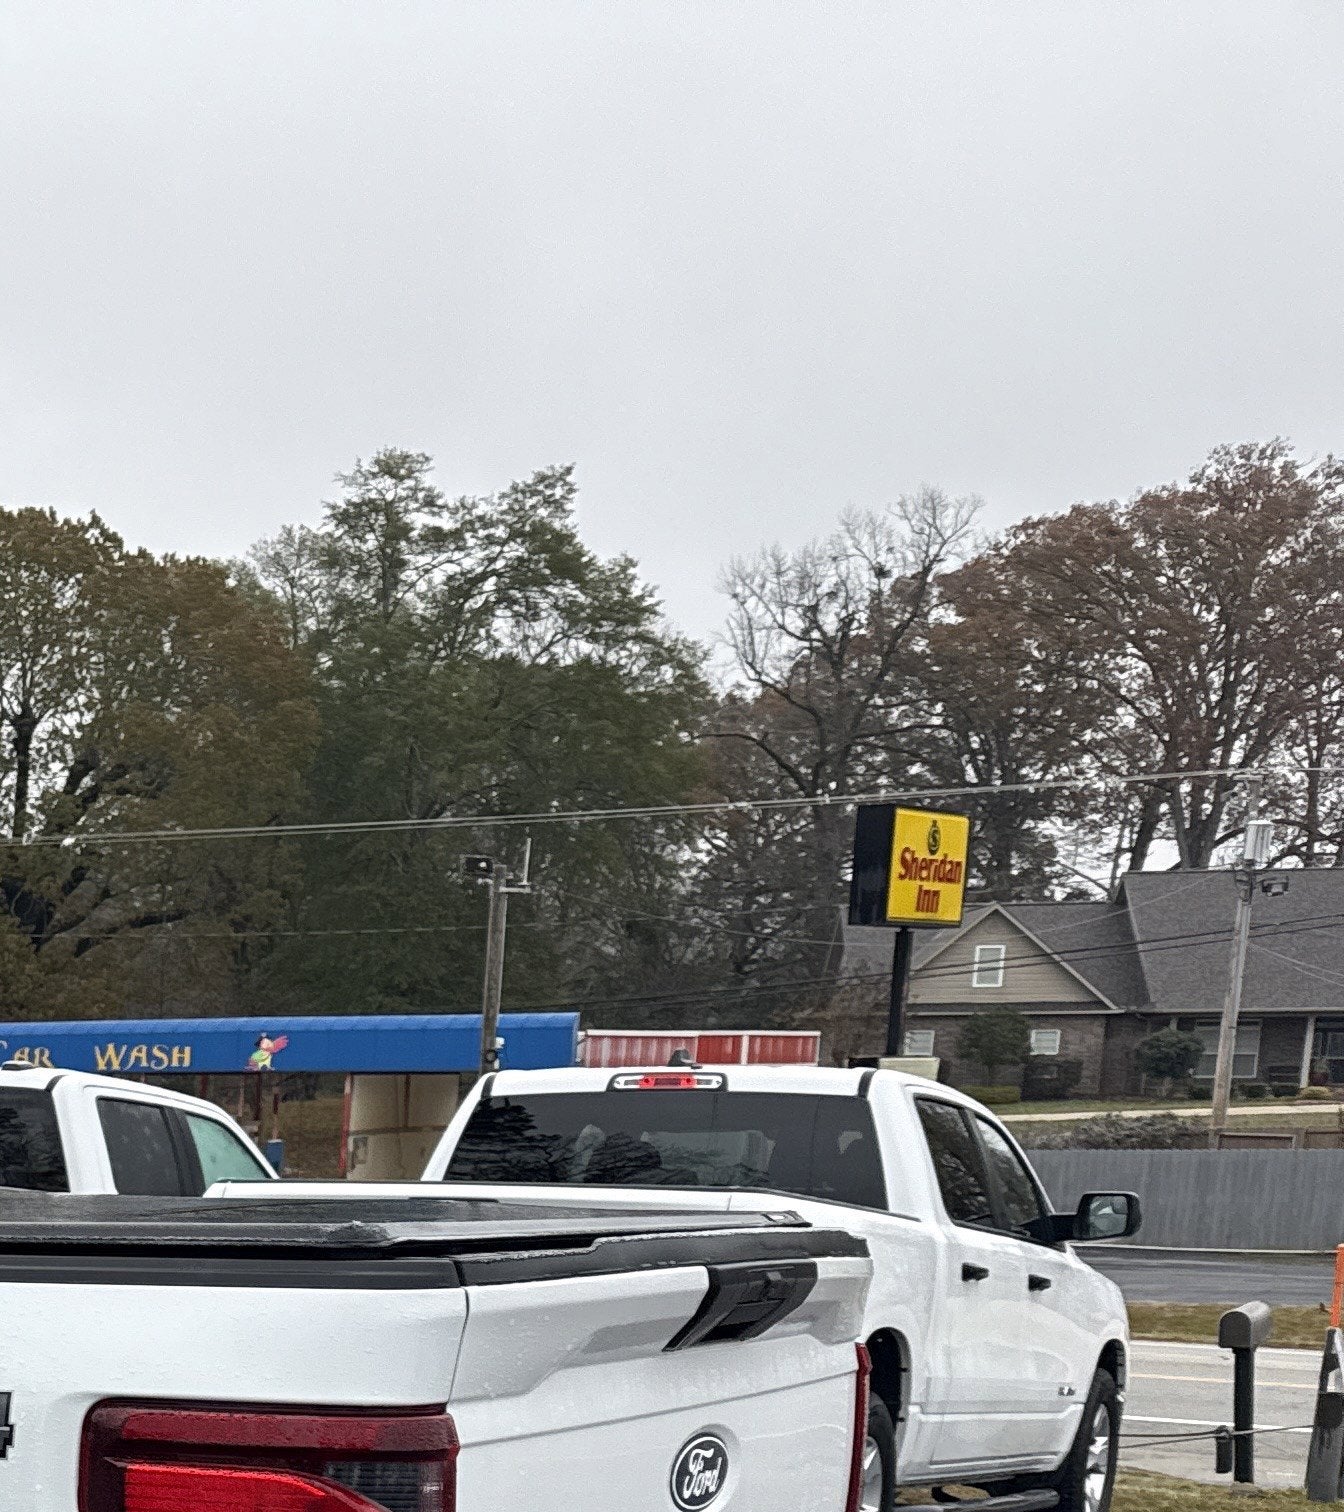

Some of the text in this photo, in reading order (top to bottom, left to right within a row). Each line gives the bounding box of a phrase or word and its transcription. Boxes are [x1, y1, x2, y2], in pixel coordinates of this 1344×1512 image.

[898, 847, 963, 884] Sheridan
[915, 885, 941, 913] Inn
[94, 1042, 192, 1070] WASH
[683, 1448, 722, 1499] Ford
